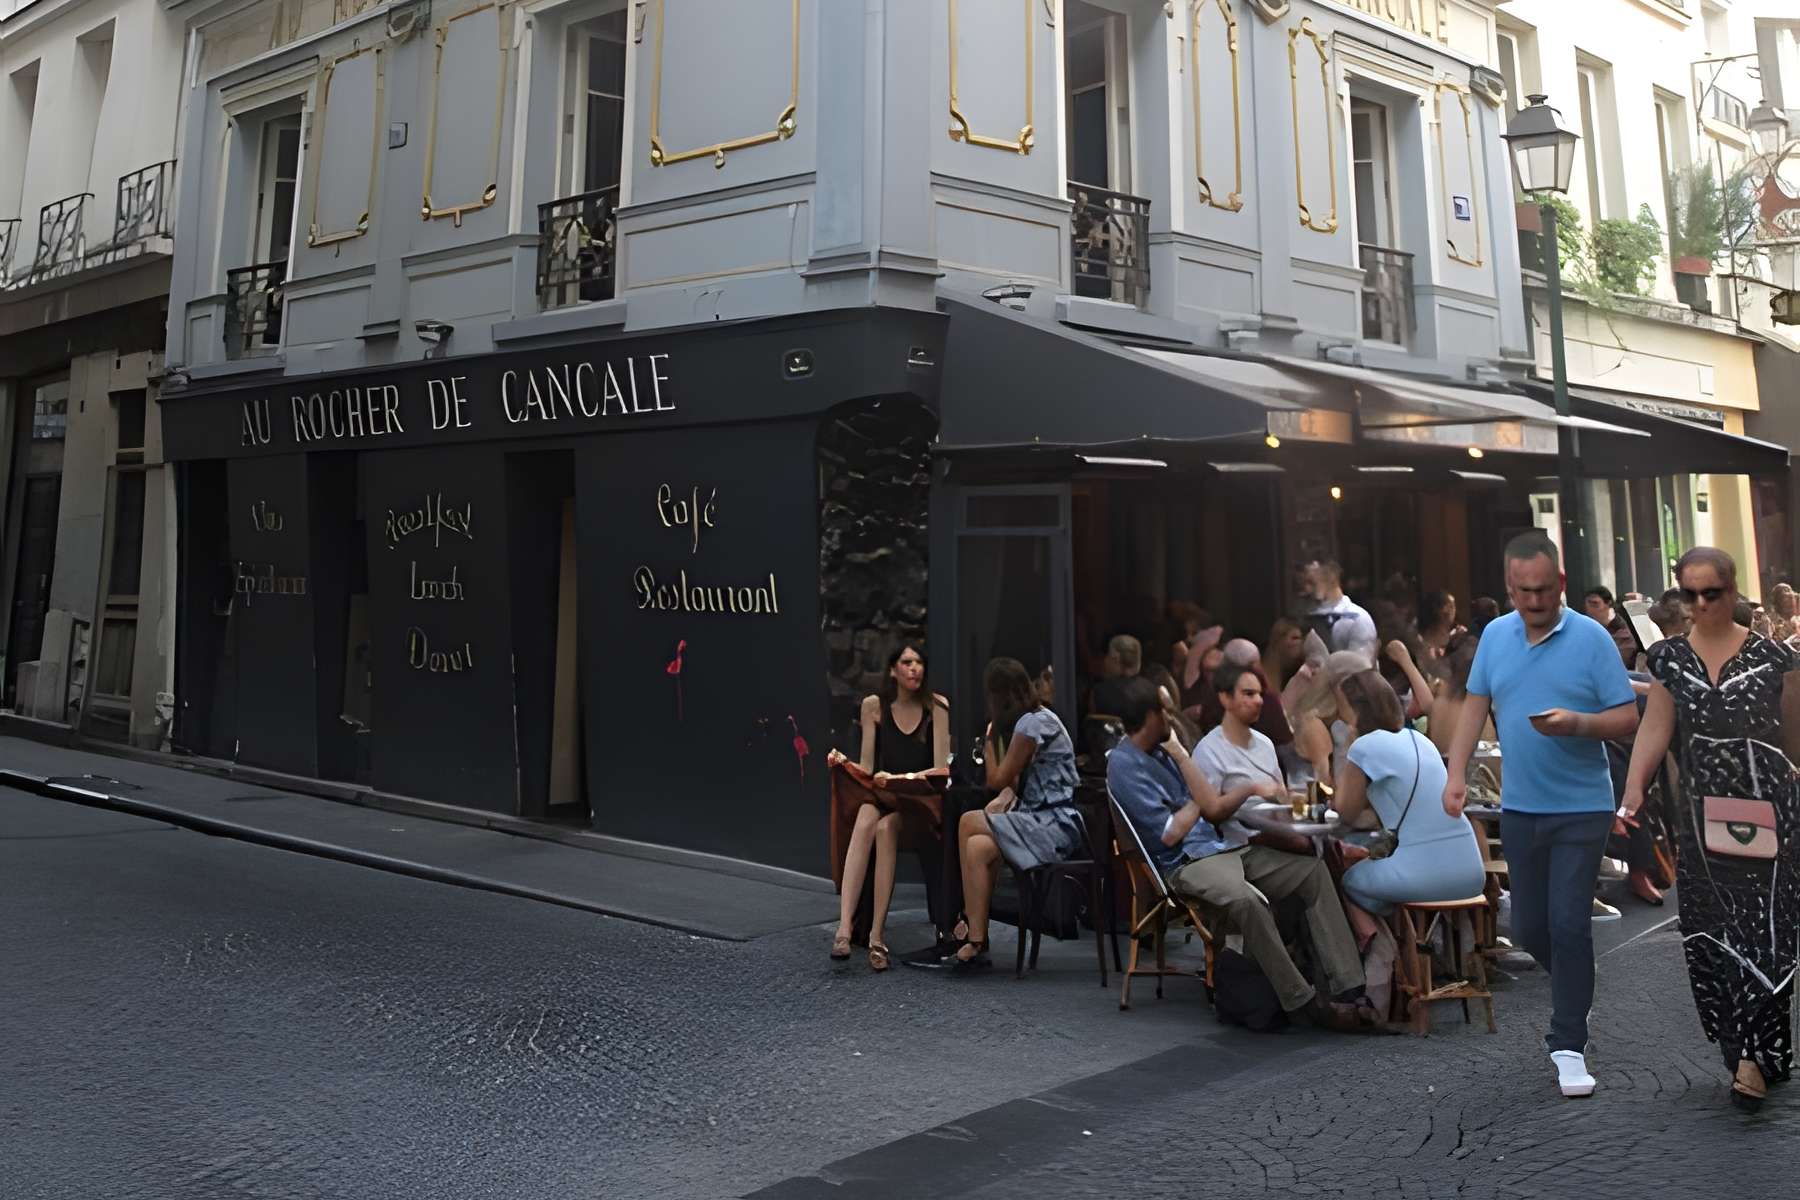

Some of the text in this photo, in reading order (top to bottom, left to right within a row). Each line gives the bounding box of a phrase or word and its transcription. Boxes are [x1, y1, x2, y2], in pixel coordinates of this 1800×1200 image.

[241, 353, 676, 447] AU ROCHER DE CANCALE
[657, 482, 717, 555] Café
